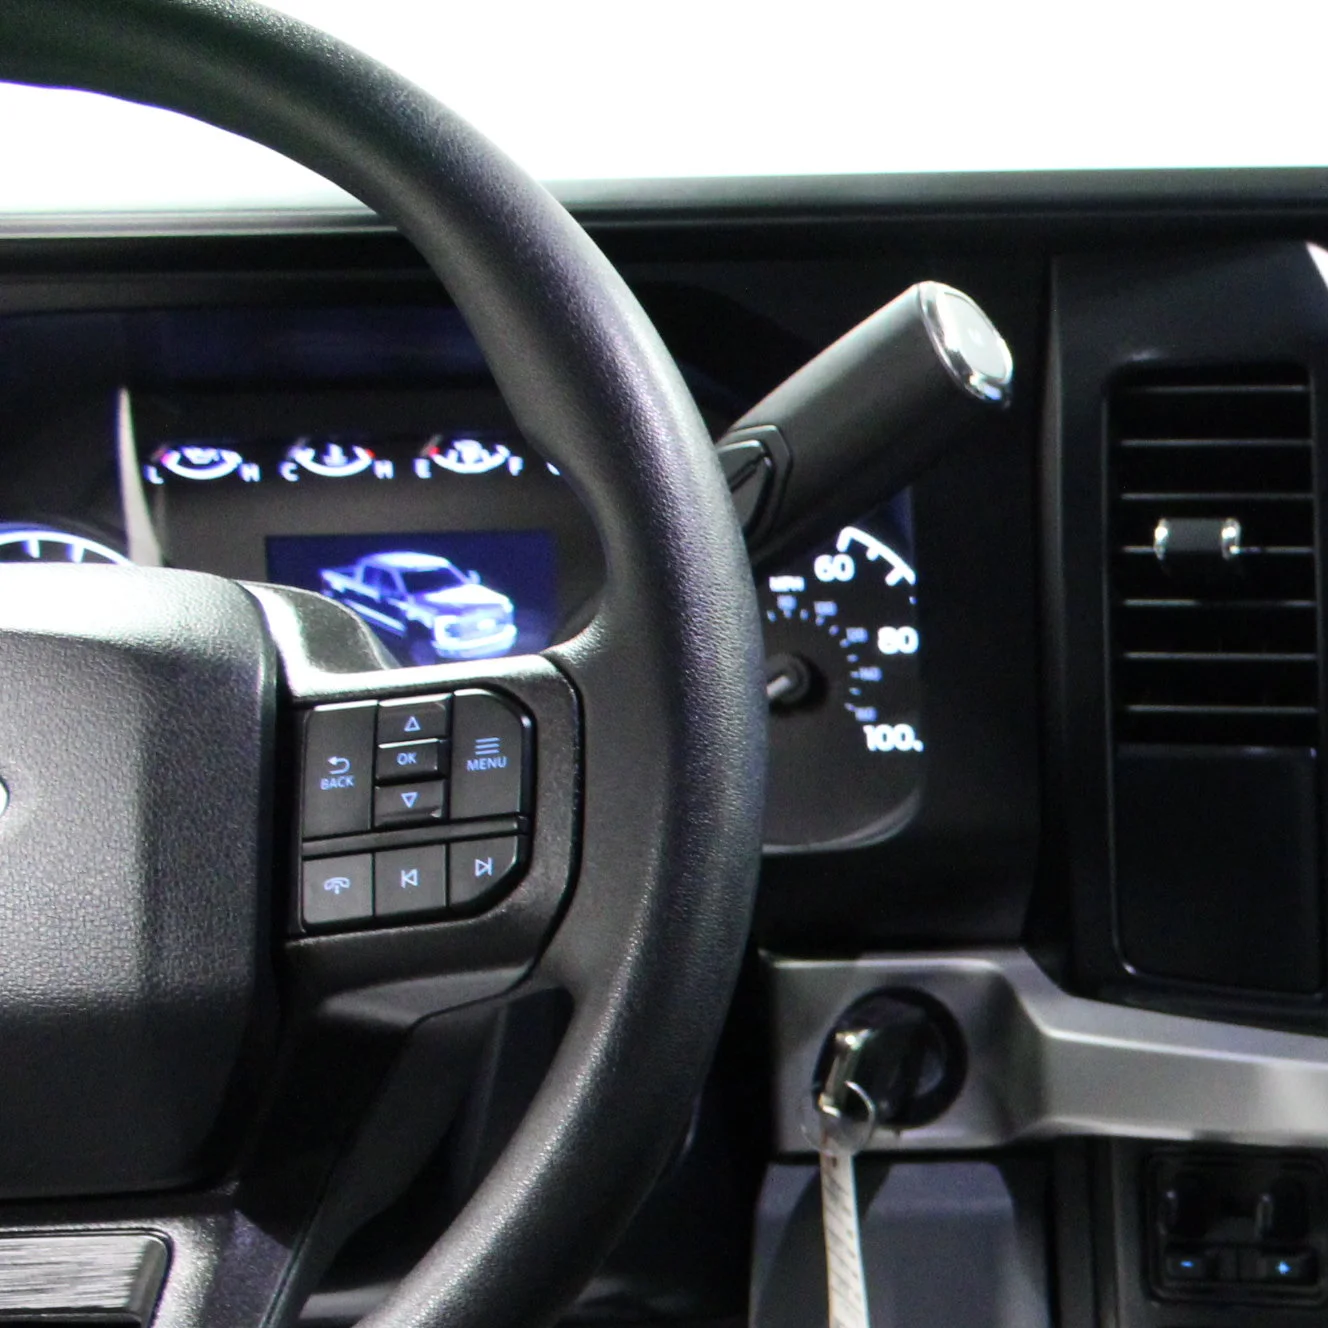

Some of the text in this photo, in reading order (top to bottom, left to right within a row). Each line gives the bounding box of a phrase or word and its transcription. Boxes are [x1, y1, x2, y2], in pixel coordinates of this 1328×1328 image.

[414, 457, 432, 479] E
[507, 455, 523, 476] F
[814, 554, 855, 582] 60
[877, 626, 919, 654] 80
[863, 723, 916, 752] 100
[397, 752, 417, 766] OK
[467, 756, 508, 772] MENU
[320, 775, 355, 791] BACK
